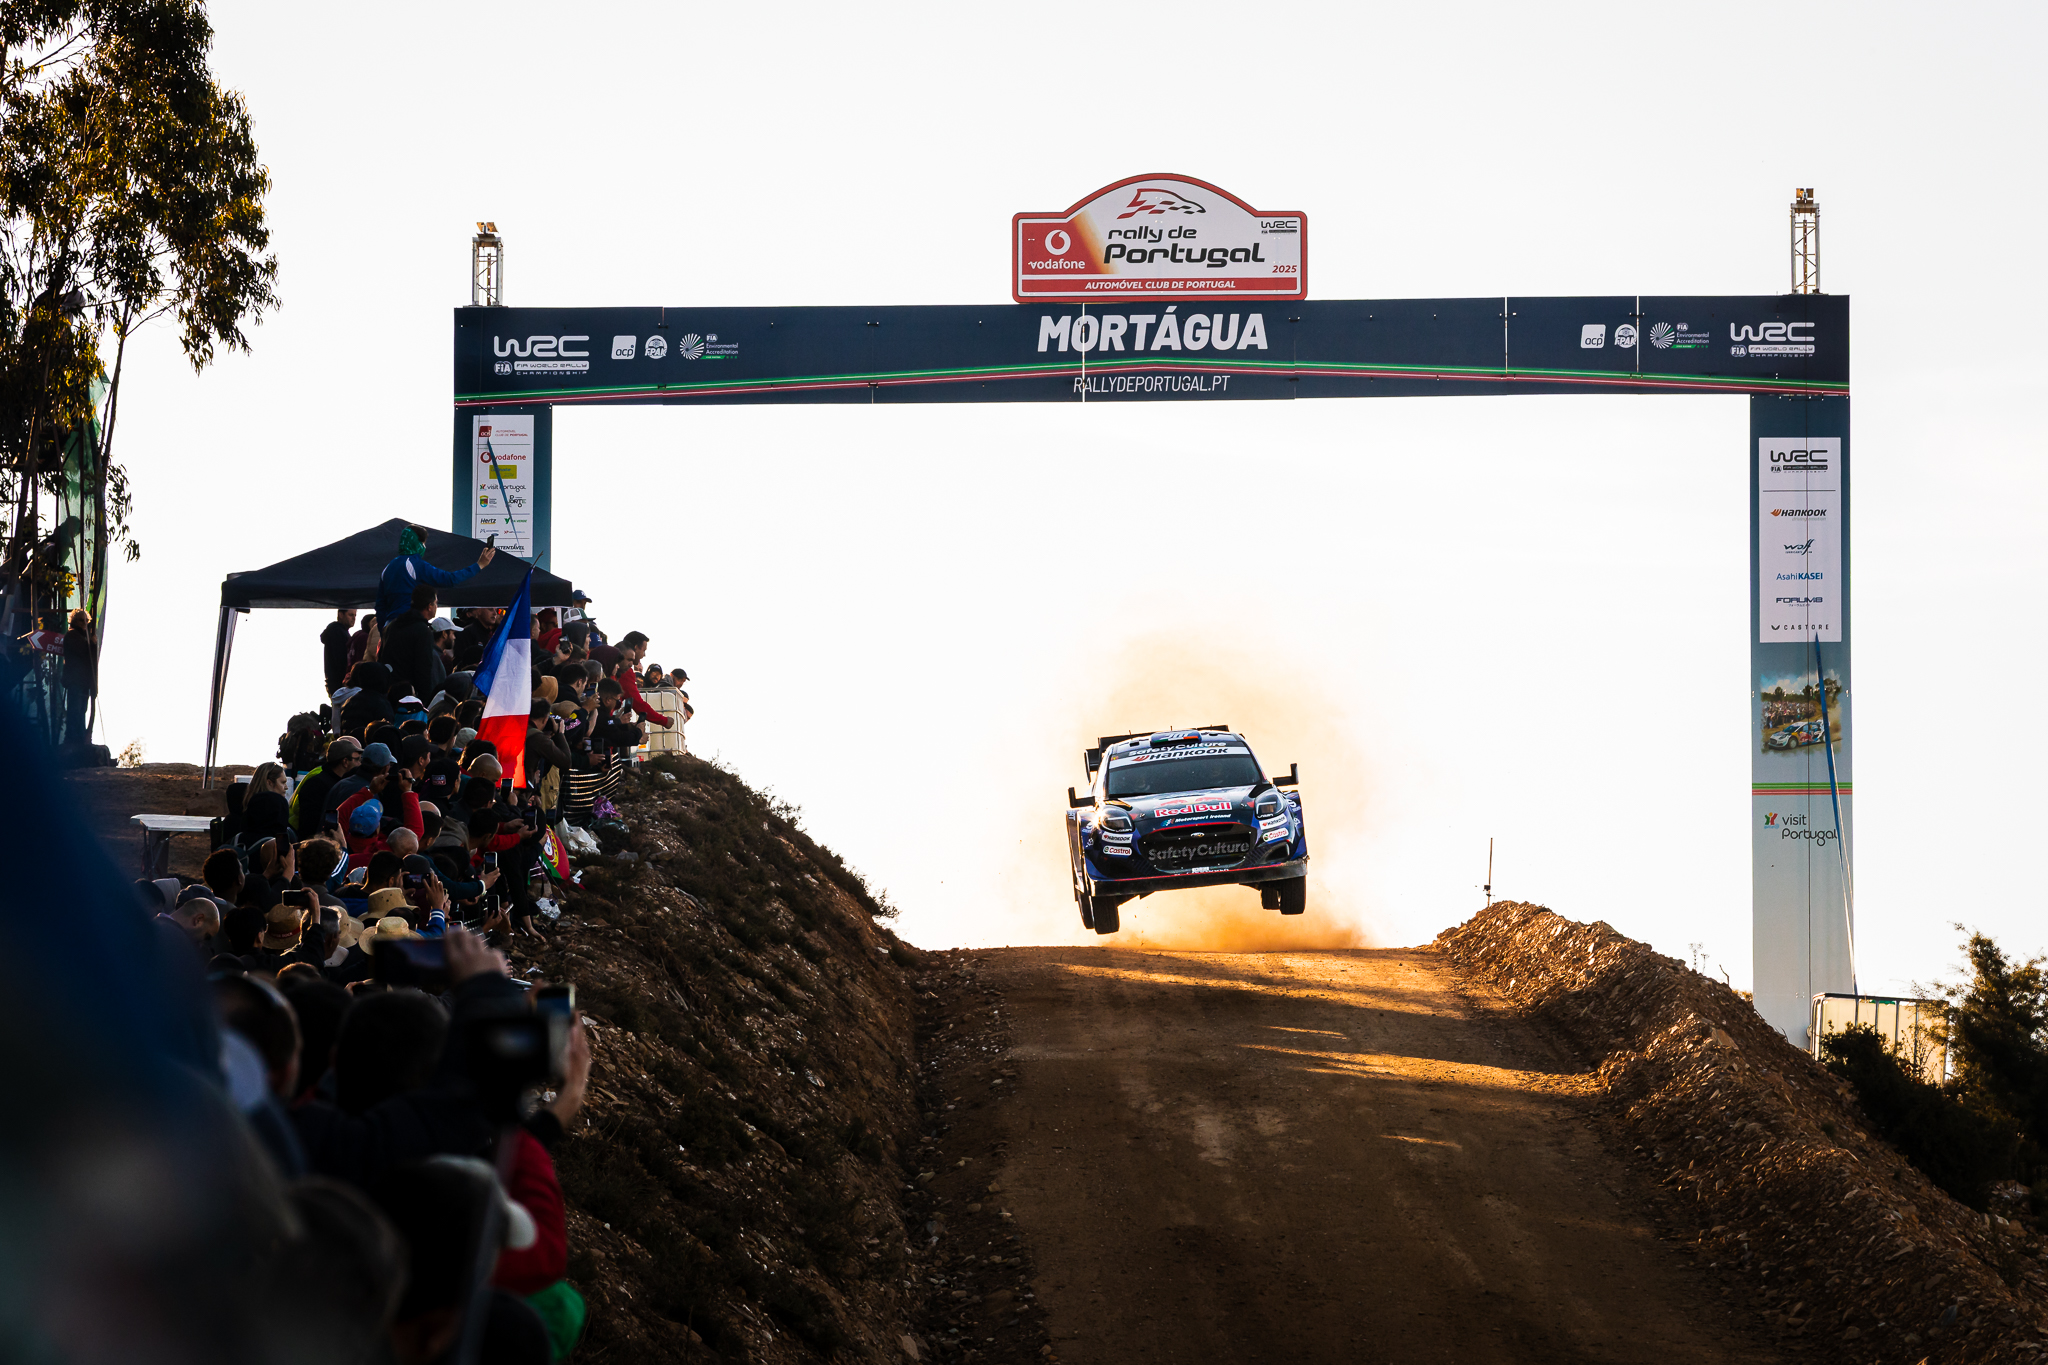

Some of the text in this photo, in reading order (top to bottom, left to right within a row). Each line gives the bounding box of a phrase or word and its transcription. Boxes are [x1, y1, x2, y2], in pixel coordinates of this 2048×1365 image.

[1108, 226, 1197, 242] rally de
[1103, 243, 1265, 268] Portugal
[1030, 259, 1086, 269] vodafone
[1272, 265, 1297, 273] 2025
[1085, 279, 1236, 290] AUTOMÓVEL CLUB DE PORTUGAL
[1037, 306, 1268, 352] MORTÁGUA
[1730, 322, 1815, 341] WRC
[493, 335, 590, 357] WRC
[1584, 338, 1603, 346] acp
[615, 349, 634, 357] acp
[645, 348, 667, 356] FPAK
[1731, 347, 1746, 355] FIA
[495, 364, 511, 373] FIA
[1073, 375, 1230, 393] RALLYDEPORTUGAL.PT
[1770, 450, 1828, 462] WRC
[1129, 742, 1226, 756] SafetyCulture
[1154, 802, 1232, 817] Red Bull
[1175, 815, 1208, 823] Motorsport
[1782, 814, 1806, 825] visit
[1269, 830, 1287, 839] Castrol
[1782, 828, 1837, 846] Portugal
[1148, 842, 1249, 860] SafetyCulture
